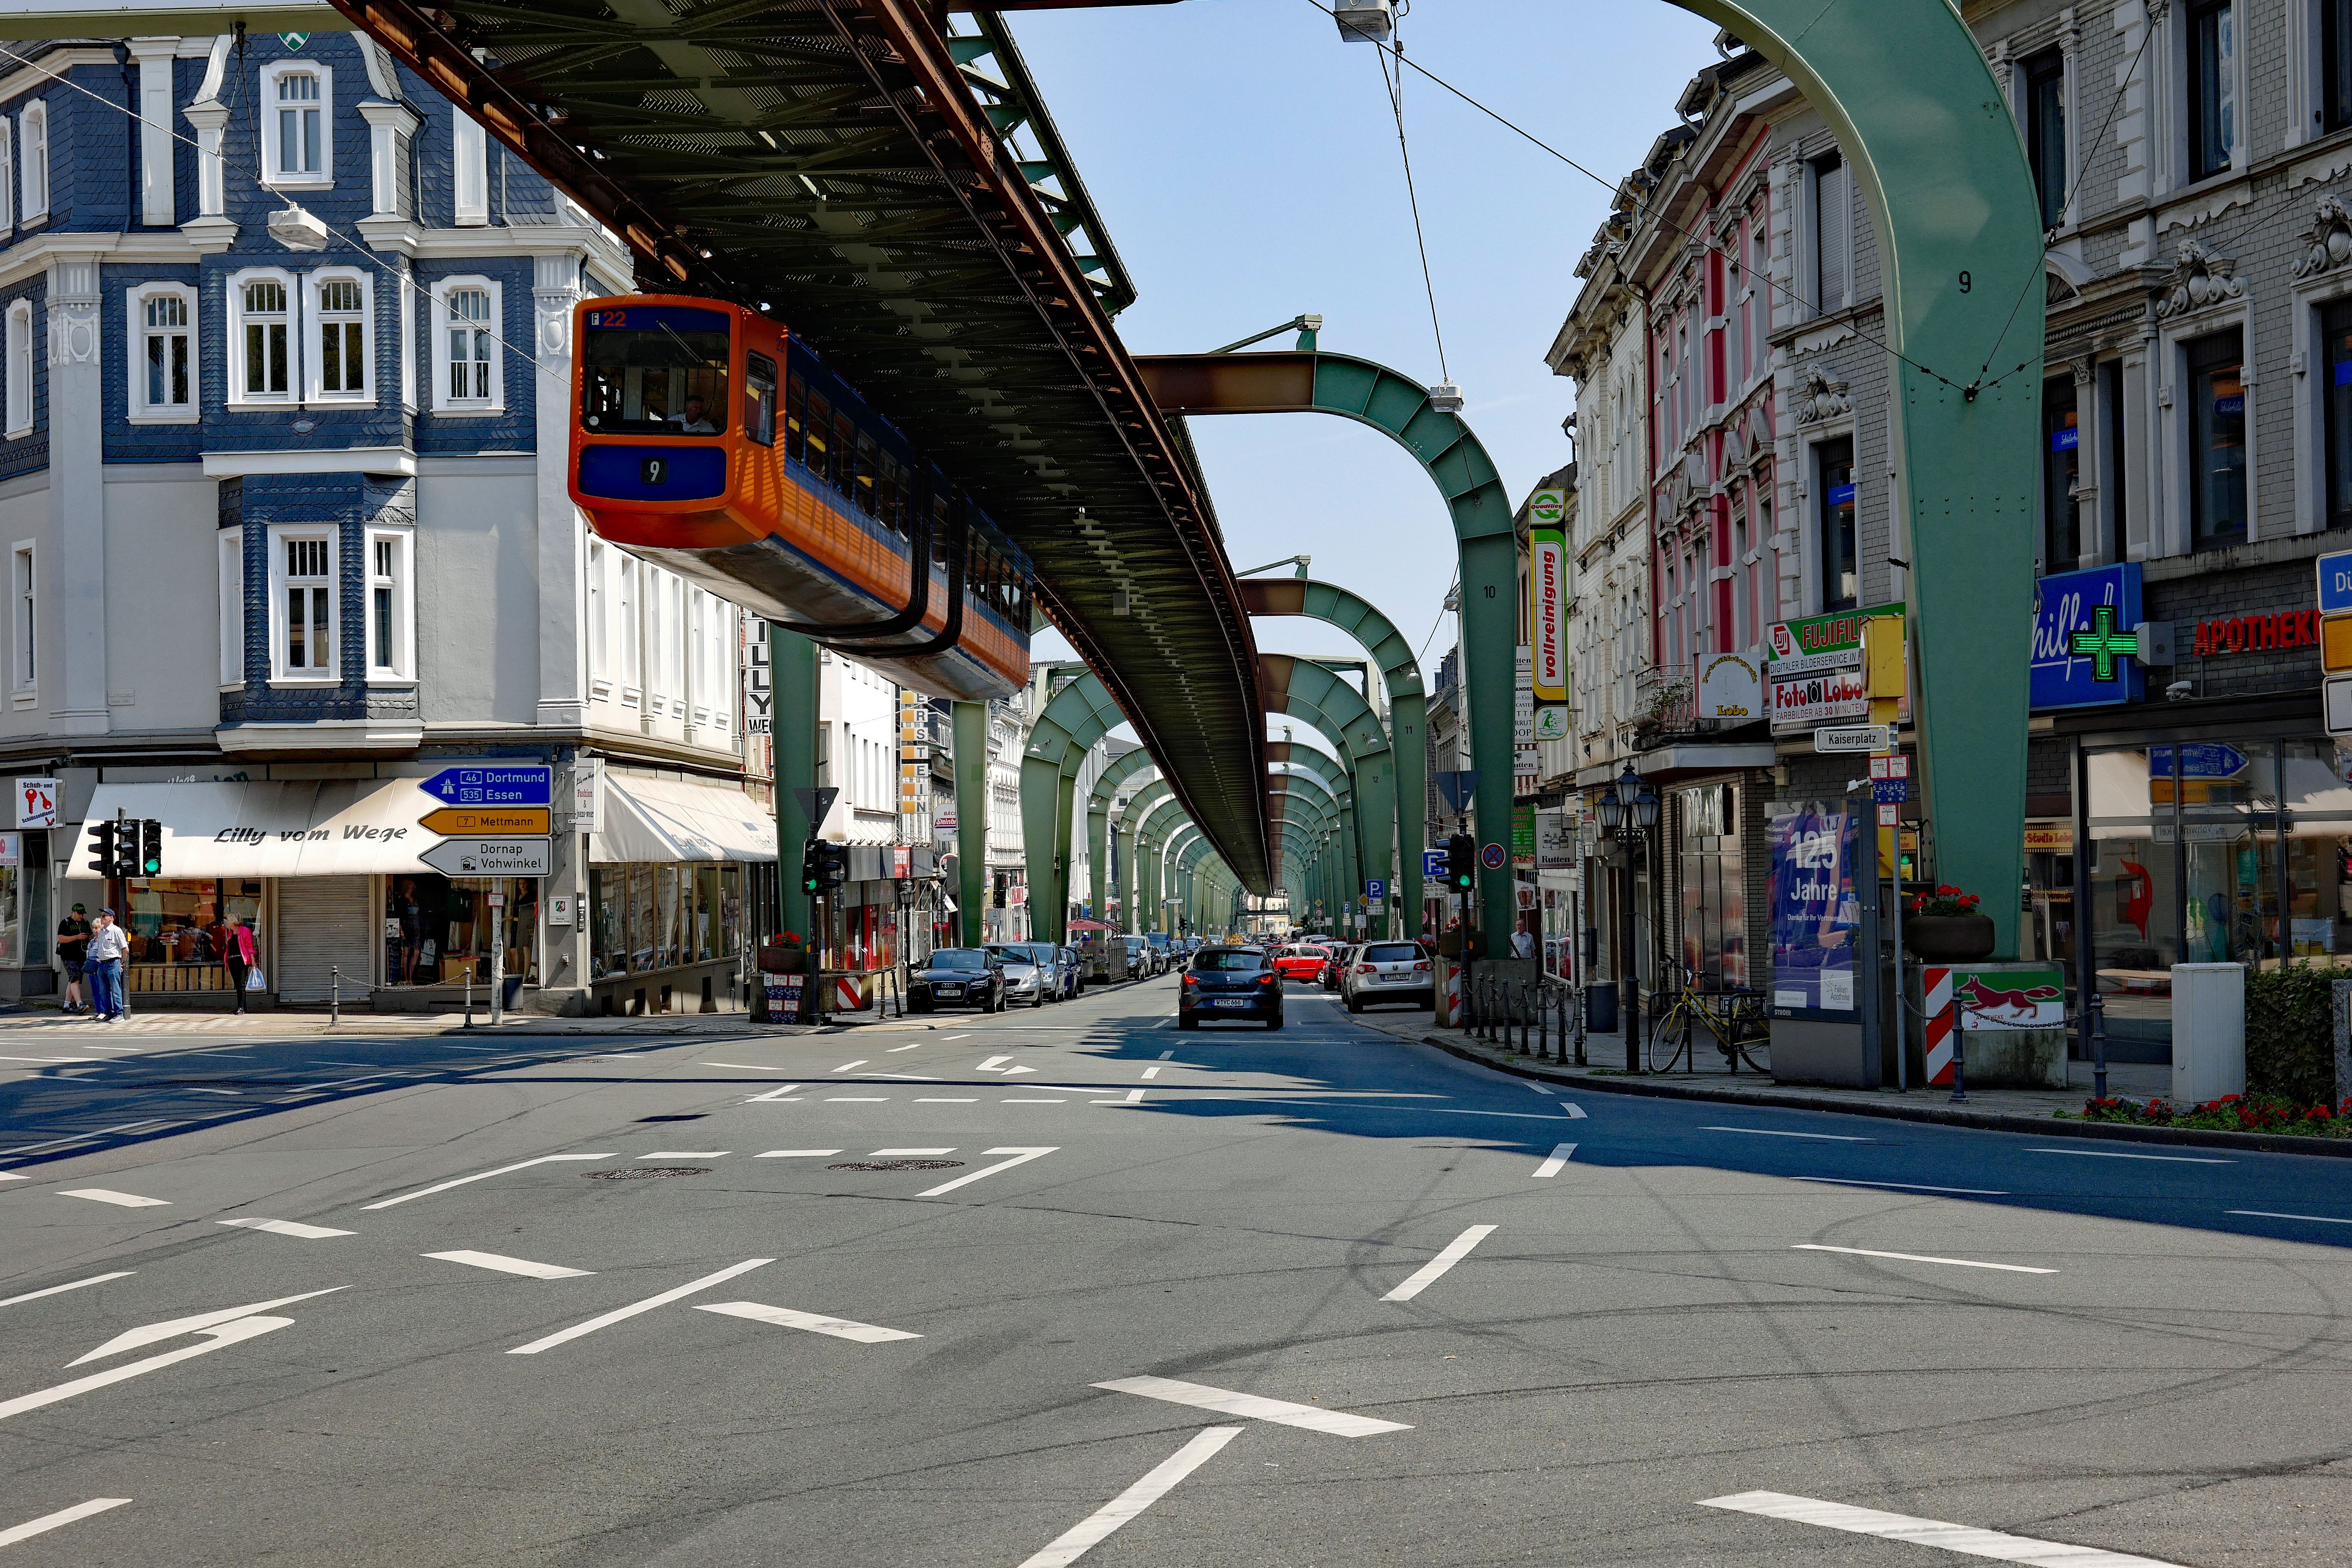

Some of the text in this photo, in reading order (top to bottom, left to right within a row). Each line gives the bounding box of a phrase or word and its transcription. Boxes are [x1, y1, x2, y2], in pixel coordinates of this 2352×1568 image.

[1959, 270, 1971, 294] 9
[592, 311, 626, 327] F 22
[777, 337, 784, 352] 22
[650, 461, 659, 481] 9
[1484, 586, 1495, 598] 10
[1543, 551, 1556, 678] vollreinigung
[749, 612, 770, 715] ILLY
[1771, 661, 1799, 673] DIGITALER
[1801, 653, 1847, 669] BILDERSERVICE
[1850, 652, 1856, 662] IN
[1776, 676, 1862, 709] Foto Lobo
[1716, 705, 1748, 717] Lobo
[1777, 703, 1864, 721] FARBBILDER AB 30 MINUTEN
[749, 719, 772, 733] WE
[1405, 726, 1413, 734] 11
[1829, 733, 1877, 746] Kaiserplatz
[466, 772, 544, 782] 46 Dortmund
[486, 789, 522, 800] Essen
[577, 789, 593, 797] Fashion
[583, 800, 587, 808] &
[22, 809, 55, 823] Schlüsseldienst
[481, 817, 533, 826] Mettmann
[214, 825, 408, 846] Lilly vom Wege
[2054, 832, 2073, 843] Lobo
[481, 844, 522, 856] Dornap
[1790, 831, 1837, 869] 125
[481, 858, 541, 868] Vohwinkel
[1370, 882, 1380, 896] P
[1791, 878, 1837, 901] Jahre
[1345, 903, 1348, 912] P
[1835, 985, 1848, 993] Falken
[1831, 993, 1850, 1002] Apotheke
